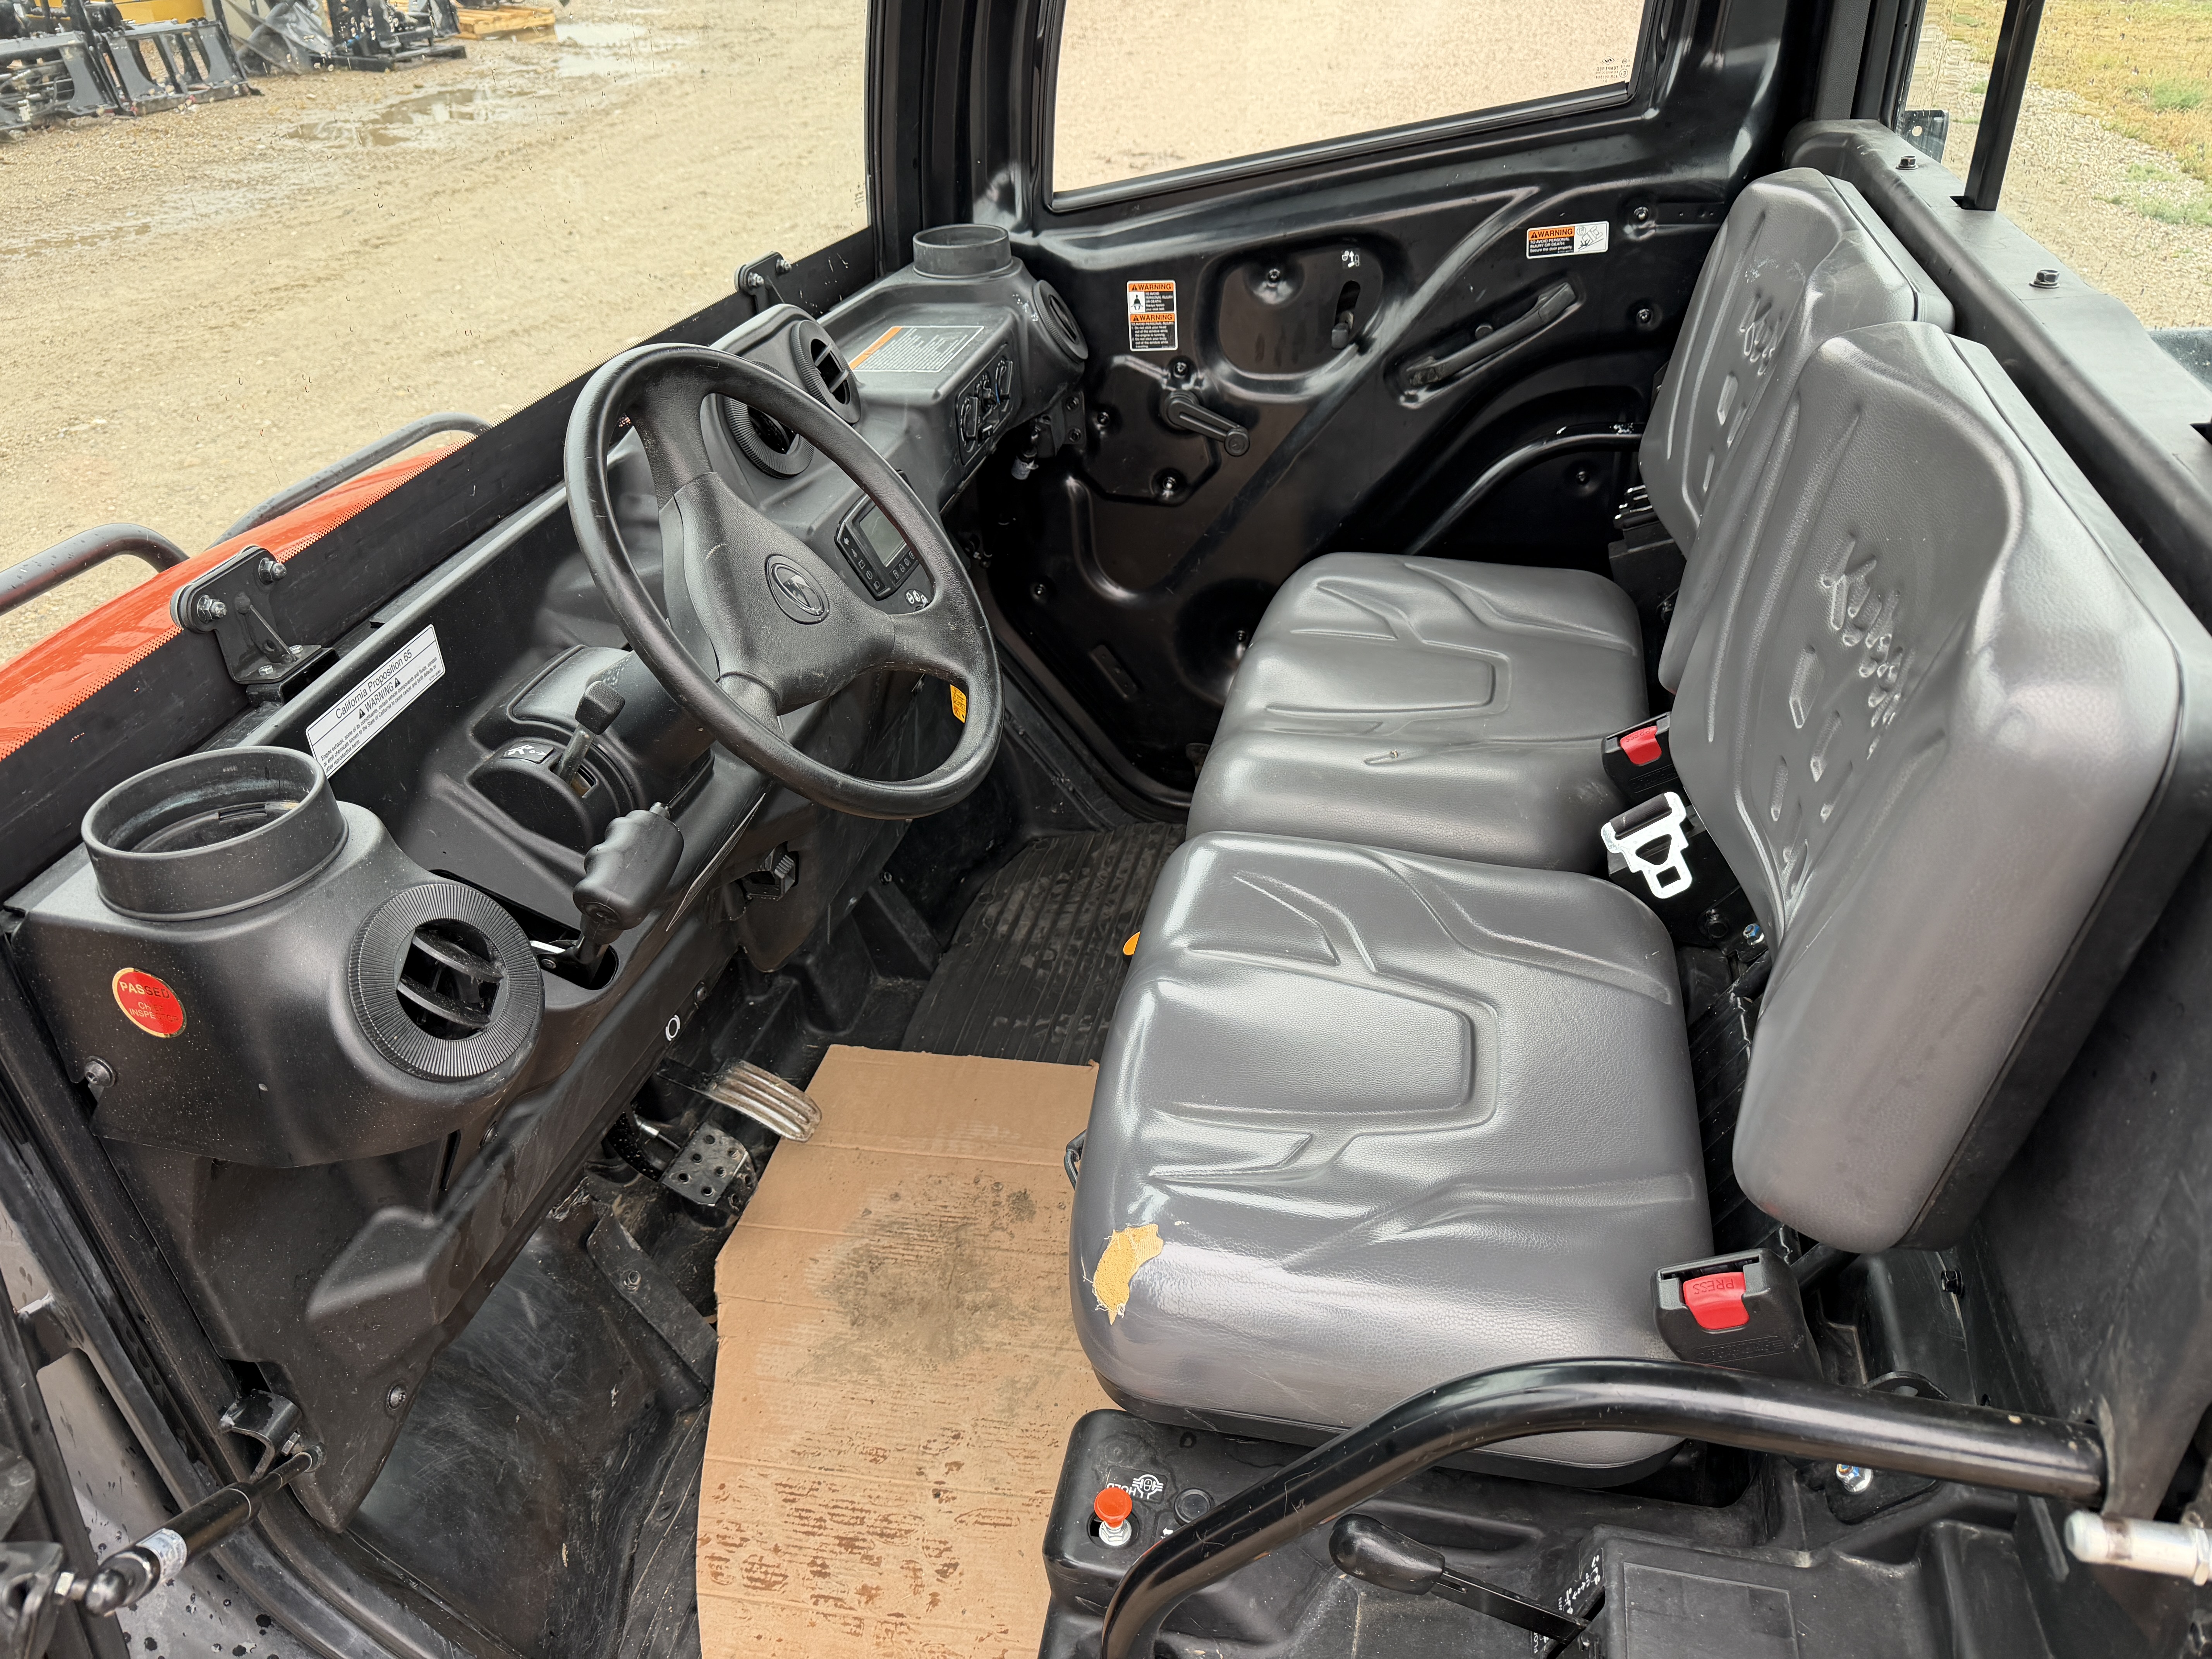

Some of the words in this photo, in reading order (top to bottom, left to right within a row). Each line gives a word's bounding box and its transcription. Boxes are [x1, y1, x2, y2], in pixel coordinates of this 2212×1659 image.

[1538, 228, 1573, 237] WARNING
[336, 689, 368, 719] California
[368, 658, 403, 692] Proposition
[404, 649, 412, 661] 65
[321, 749, 331, 761] Engine
[344, 730, 352, 740] some
[378, 699, 388, 709] certain
[388, 691, 397, 701] vehicle
[398, 677, 414, 693] components
[427, 657, 437, 667] contain
[364, 682, 393, 712] WARNING
[334, 742, 349, 757] chemicals
[349, 733, 359, 744] known
[378, 704, 392, 717] California
[395, 694, 403, 703] cause
[403, 685, 412, 696] cancer
[424, 667, 433, 677] defects
[333, 747, 352, 765] reproductive
[118, 981, 170, 999] PASSED
[1692, 1278, 1735, 1295] PRESS
